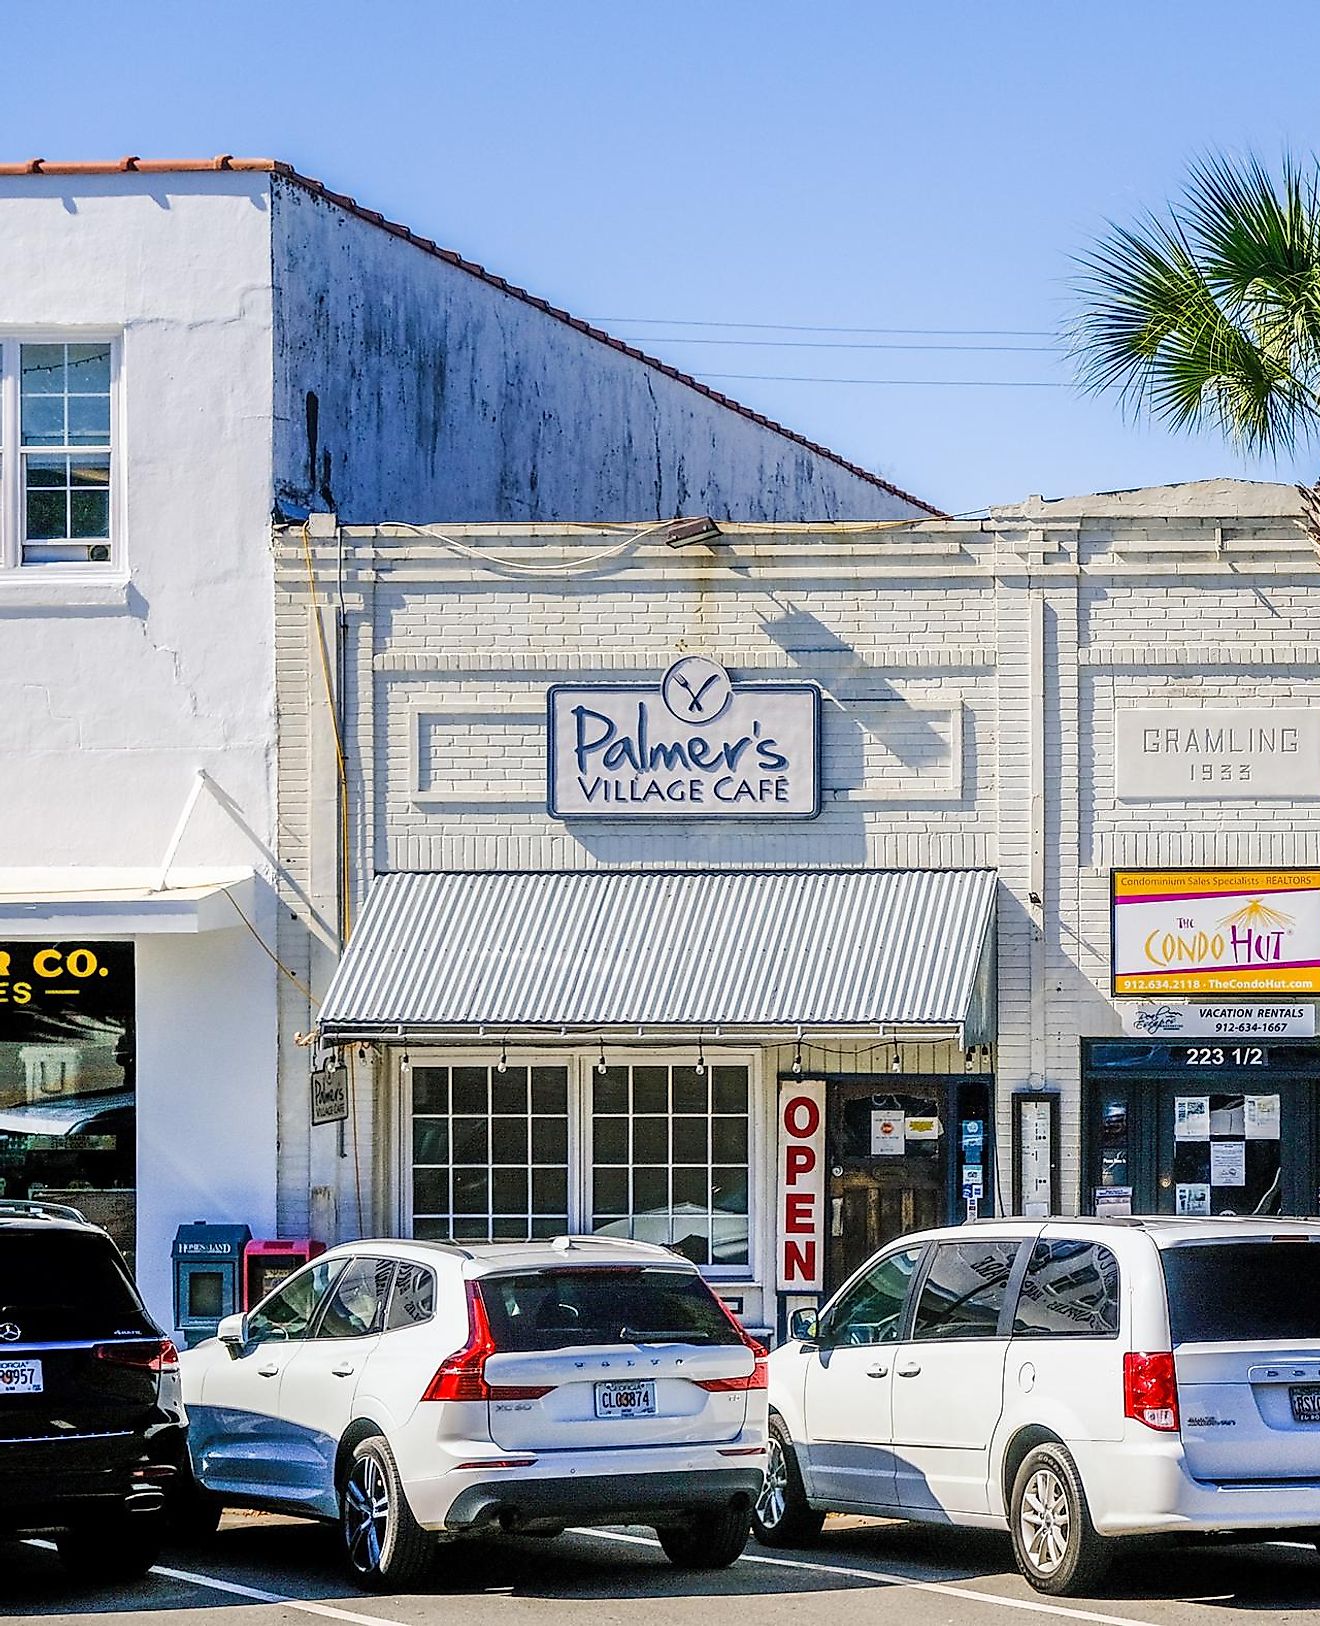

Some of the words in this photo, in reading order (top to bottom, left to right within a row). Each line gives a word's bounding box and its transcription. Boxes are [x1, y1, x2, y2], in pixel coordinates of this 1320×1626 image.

[570, 701, 790, 775] Palmer's
[1143, 728, 1298, 753] GRAMLING
[1190, 764, 1251, 781] 1933
[577, 776, 703, 802] VILLAGE
[1120, 876, 1186, 886] Condominium
[1187, 875, 1211, 886] Sales
[1212, 875, 1259, 887] Specialists
[1176, 917, 1194, 929] THE
[1144, 929, 1225, 967] CONDO
[1230, 925, 1285, 963] HUT
[33, 948, 109, 978] CO.
[1124, 980, 1200, 990] 912.634.2118
[1208, 979, 1313, 989] TheCondoHut.com
[1199, 1008, 1252, 1018] VACATION
[1257, 1008, 1304, 1018] RENTALS
[1215, 1022, 1288, 1033] 912-634-1667
[1186, 1048, 1224, 1065] 223
[1231, 1048, 1263, 1065] 1/2
[783, 1096, 820, 1281] OPEN
